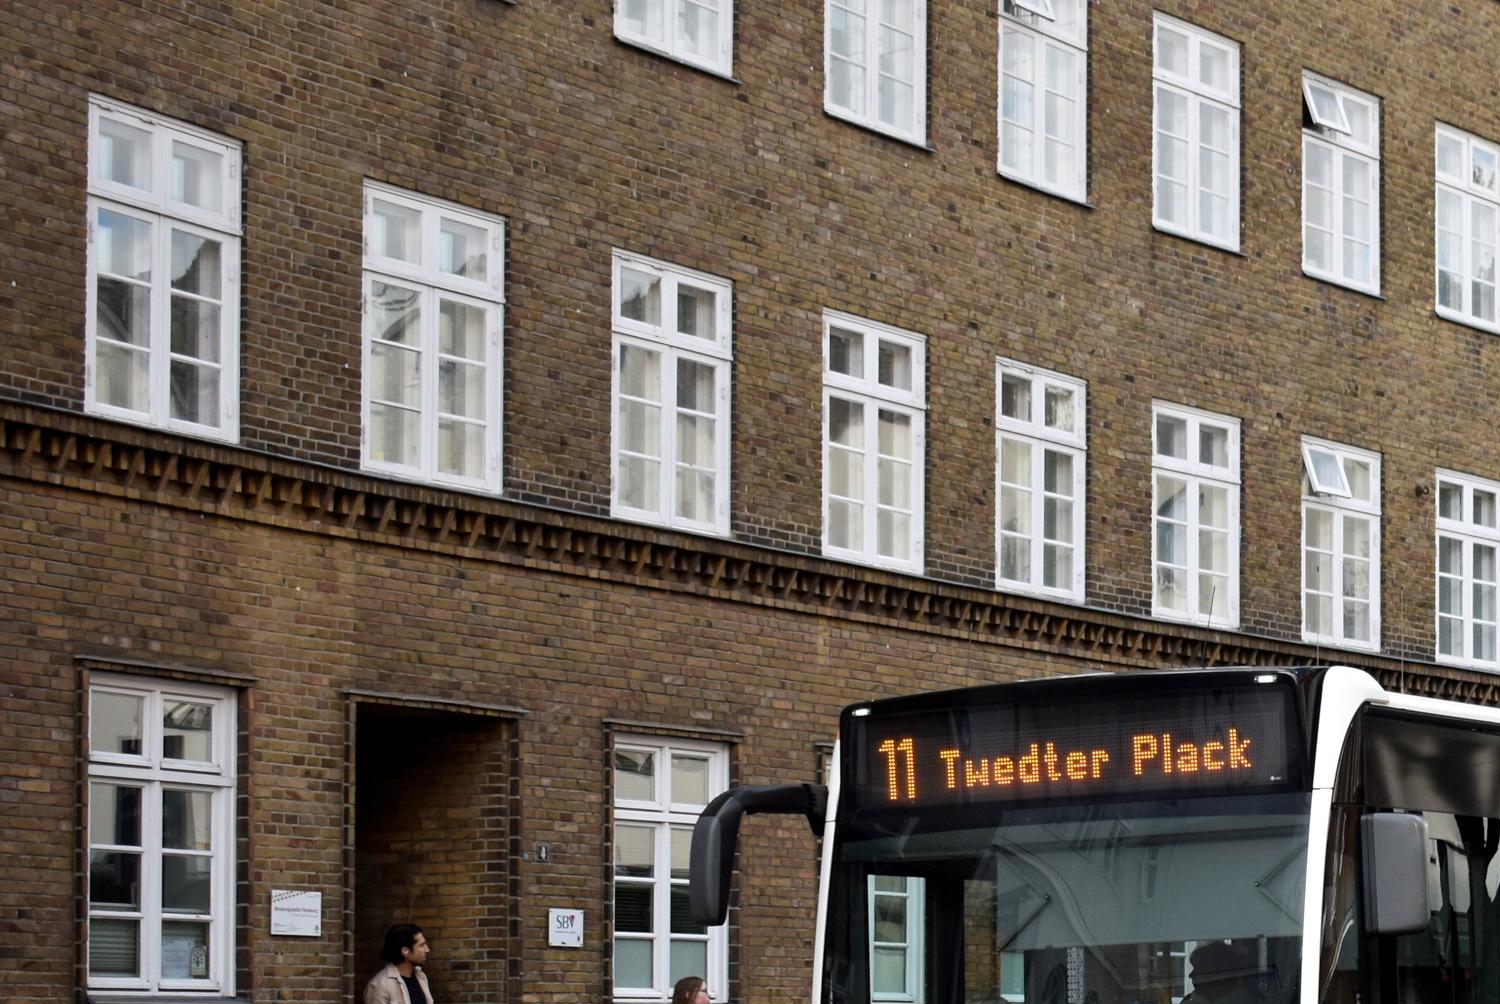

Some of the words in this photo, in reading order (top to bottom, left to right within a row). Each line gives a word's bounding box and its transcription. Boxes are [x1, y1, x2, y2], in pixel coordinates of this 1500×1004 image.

[879, 738, 916, 800] 11
[940, 742, 1109, 789] Twedter
[1133, 728, 1252, 775] Plack
